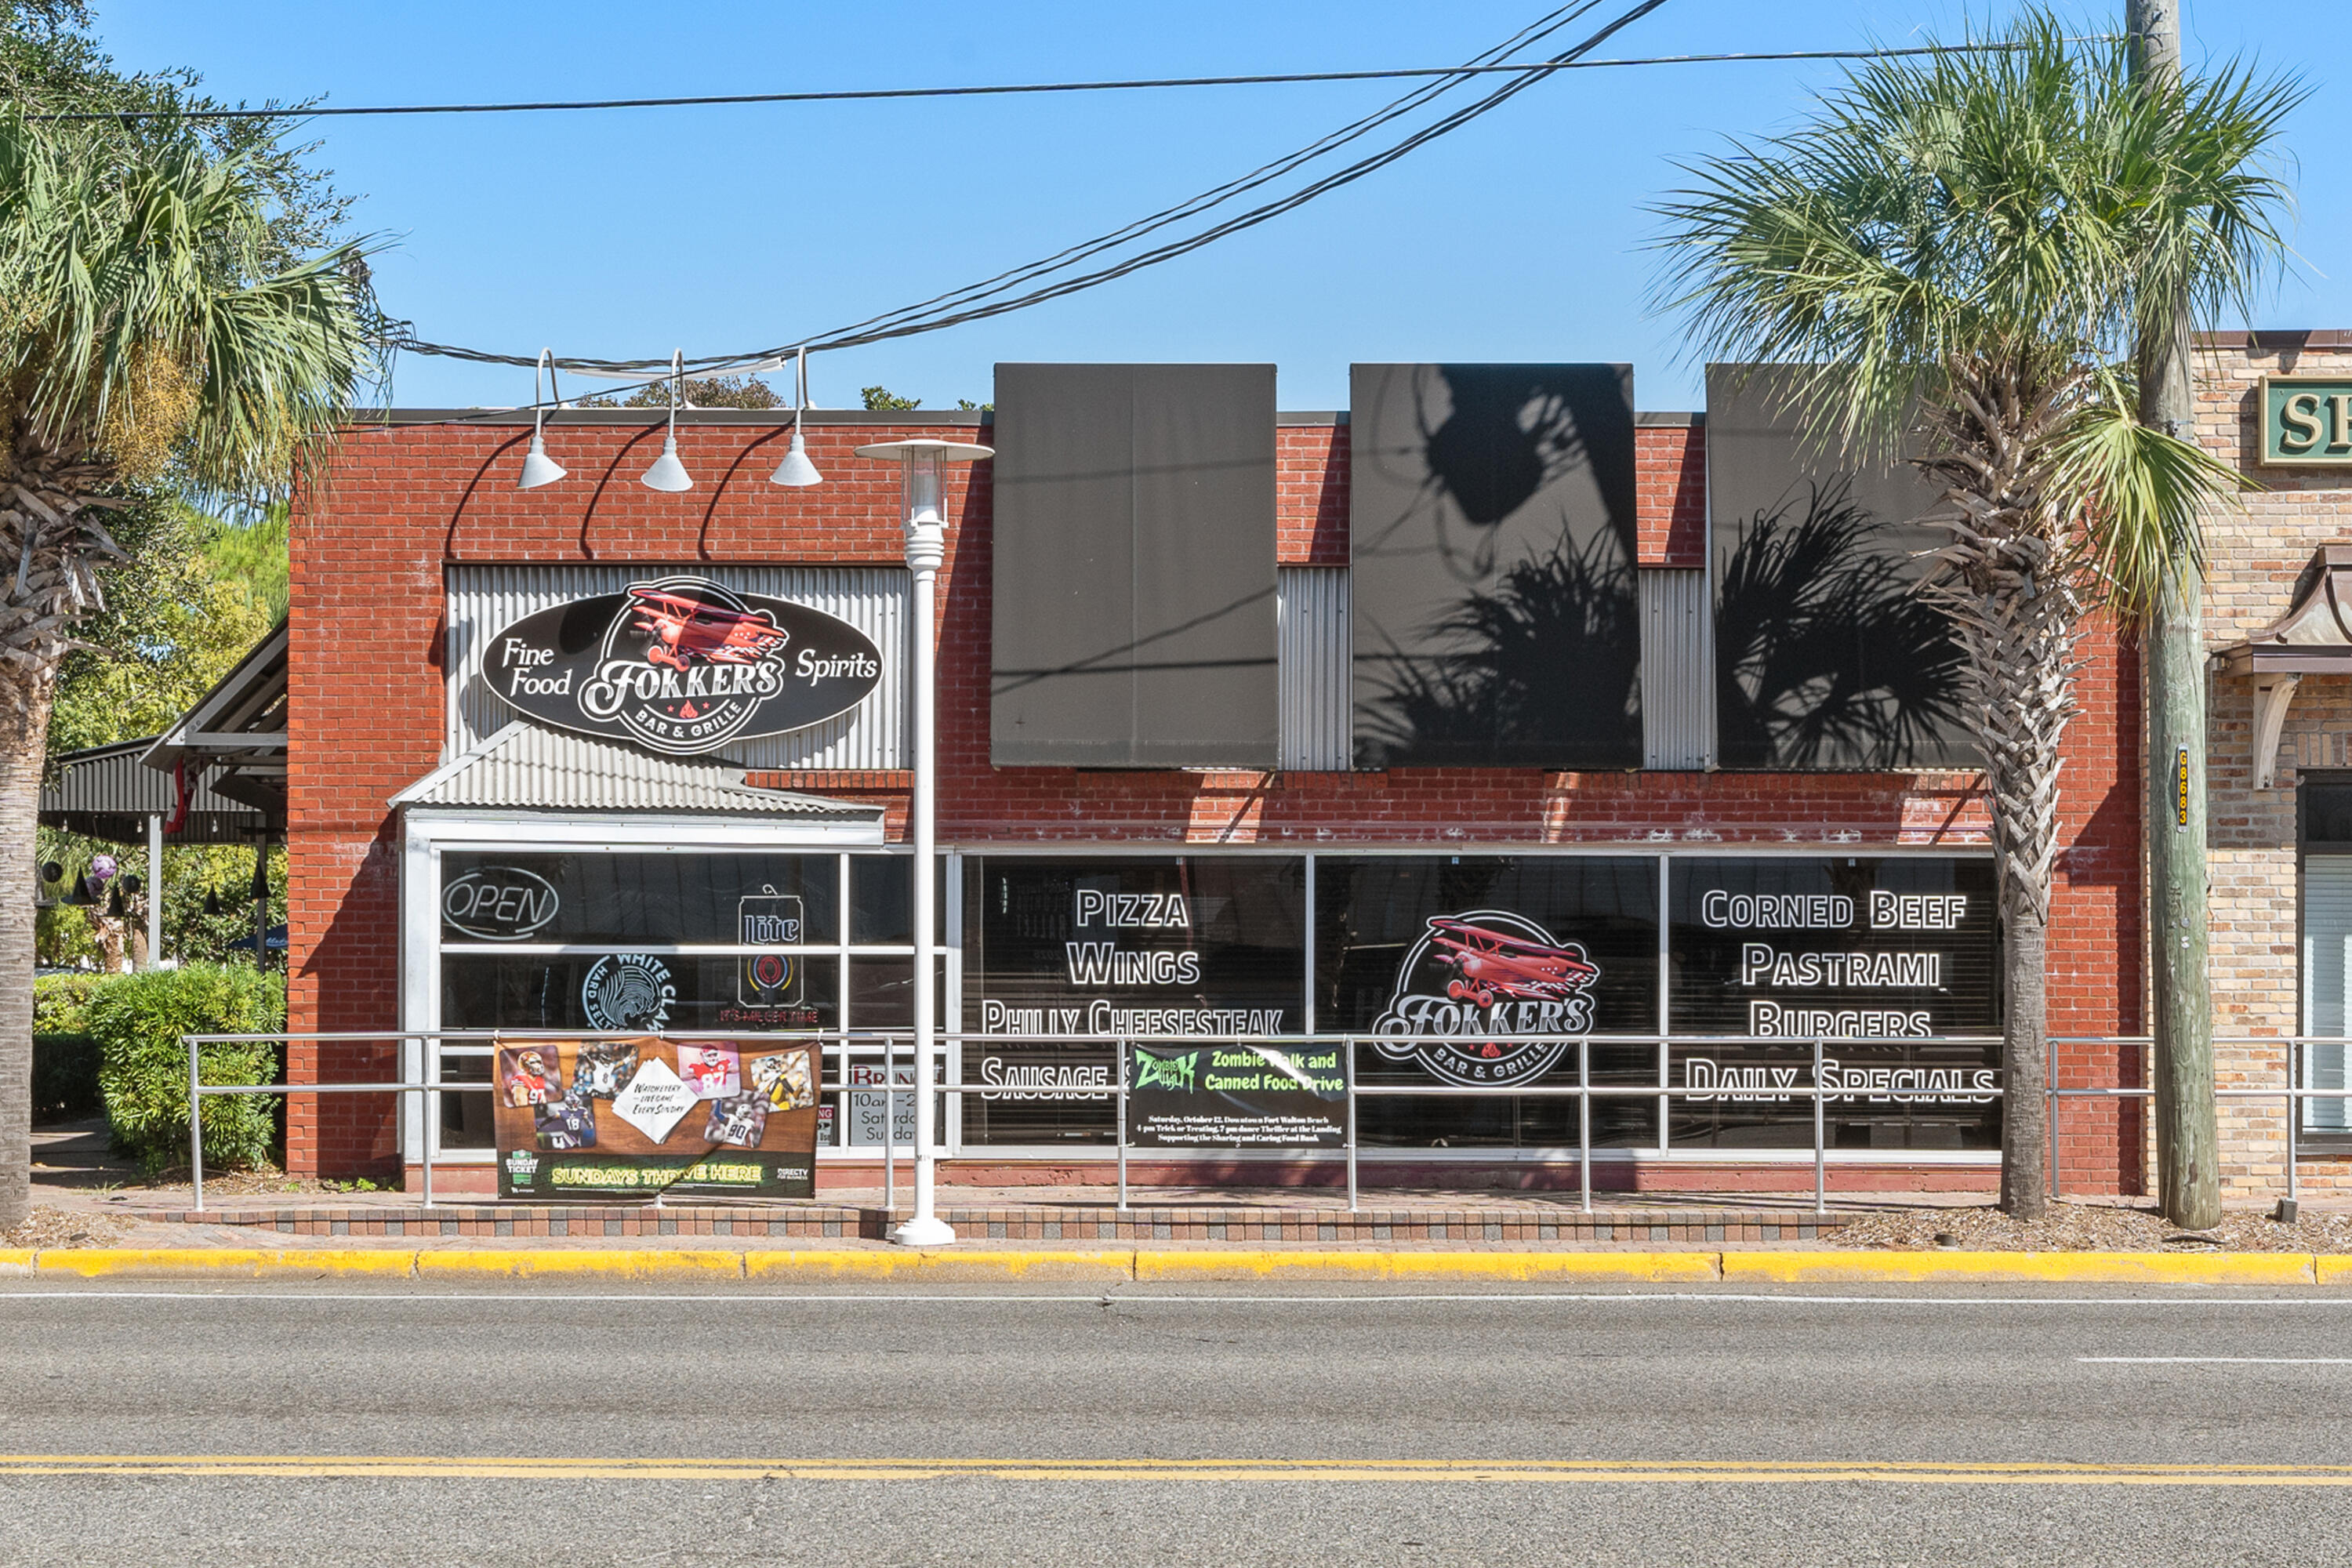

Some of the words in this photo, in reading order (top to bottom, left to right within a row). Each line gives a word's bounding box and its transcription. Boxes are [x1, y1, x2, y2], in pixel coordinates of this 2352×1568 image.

[503, 638, 554, 668] Fine
[796, 649, 877, 687] Spirits
[510, 667, 570, 697] Food
[635, 710, 668, 735] BAR
[673, 725, 684, 739] &
[690, 702, 742, 736] GRILLE
[447, 883, 548, 924] OPEN
[1076, 890, 1189, 927] PIZZA
[1702, 890, 1854, 928] CORNED
[1871, 890, 1967, 929] BEEF
[744, 915, 799, 946] Lite
[1066, 942, 1200, 985] WINGS
[1742, 943, 1940, 987] PASTRAMI
[588, 966, 608, 999] HARD
[616, 954, 671, 983] WHITE
[646, 985, 677, 1032] CLAW
[1750, 1000, 1932, 1036] BURGERS
[981, 1057, 1108, 1099] SAUSAGE
[1211, 1050, 1265, 1067] Zombie
[1308, 1052, 1336, 1069] and
[1433, 1047, 1467, 1075] BAR
[1473, 1065, 1486, 1079] &
[1494, 1043, 1548, 1079] GRILLE
[1205, 1073, 1260, 1090] Canned
[1686, 1058, 1798, 1102] DAILY
[1813, 1059, 1994, 1103] SPECIALS
[552, 1166, 638, 1185] SUNDAYS
[710, 1164, 762, 1181] HERE
